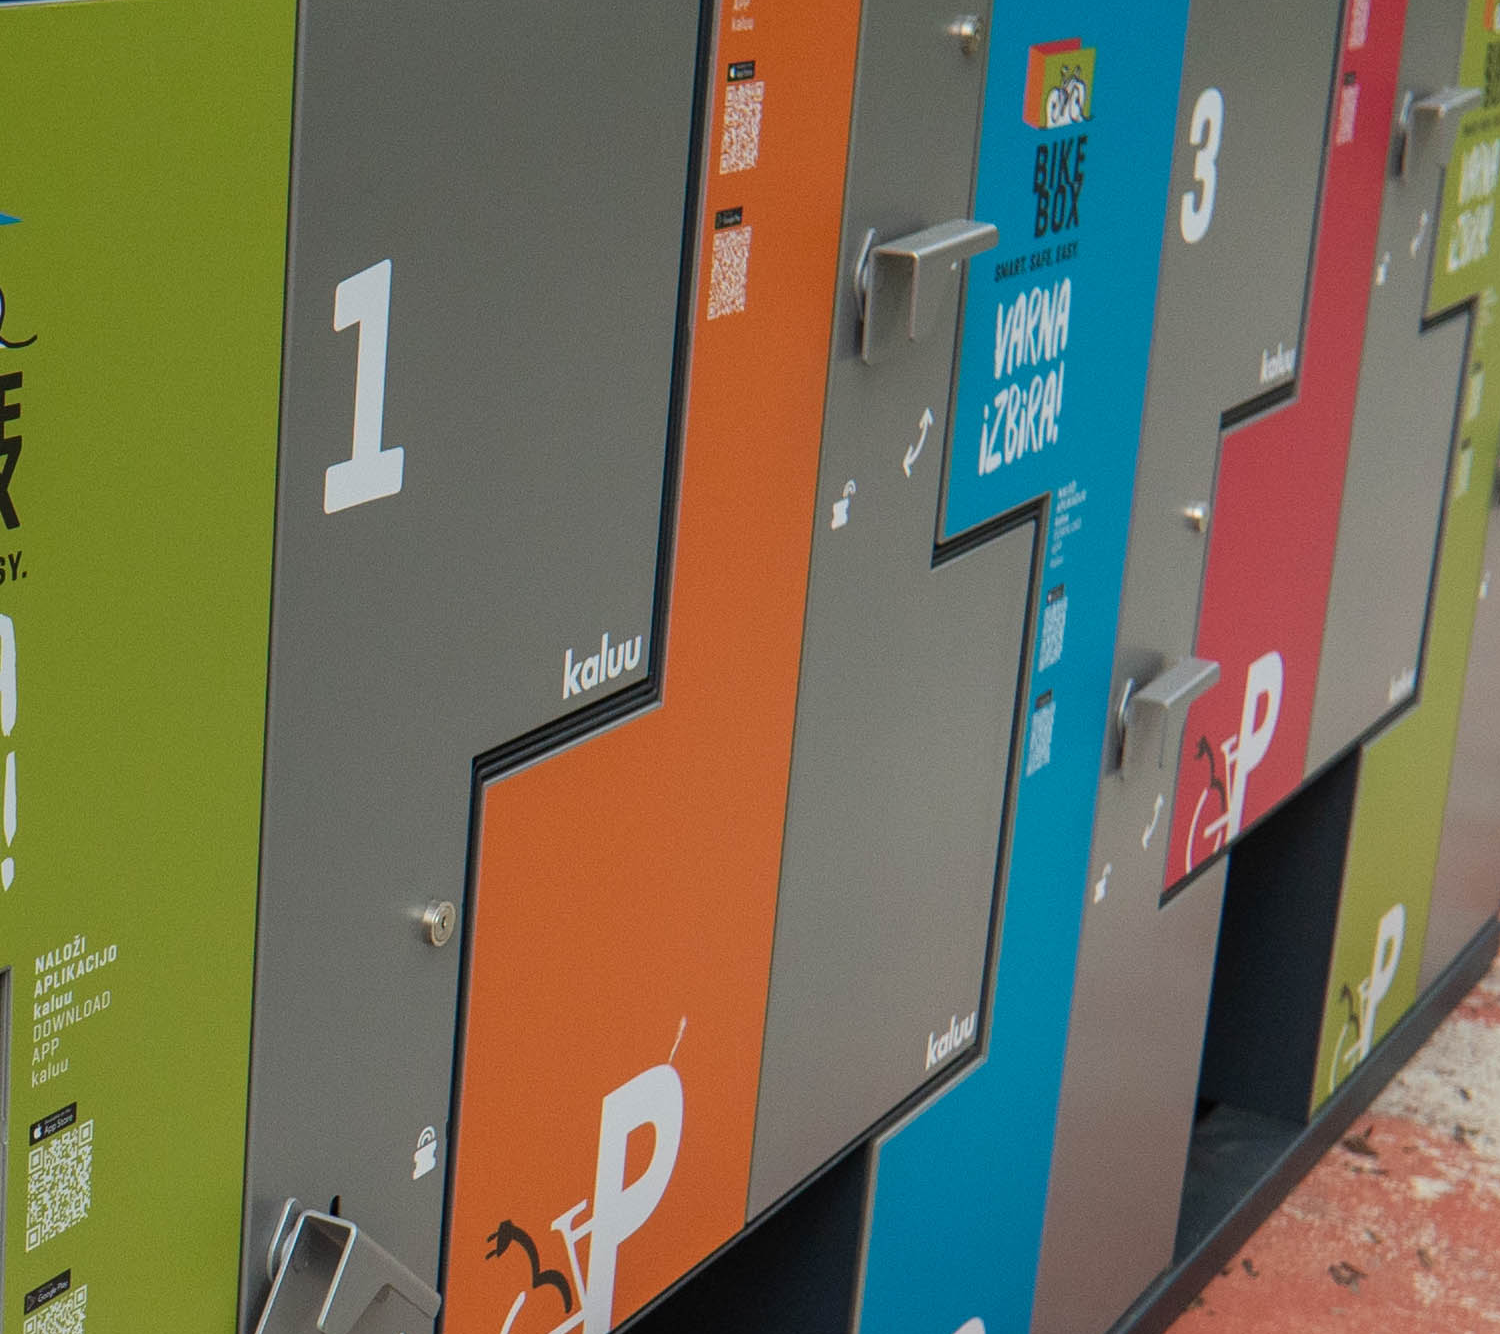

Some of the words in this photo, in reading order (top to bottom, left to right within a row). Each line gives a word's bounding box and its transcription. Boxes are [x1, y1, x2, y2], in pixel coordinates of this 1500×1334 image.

[1032, 135, 1089, 194] BIKE
[1180, 87, 1225, 244] 3
[1034, 181, 1084, 238] BOX
[993, 277, 1071, 380] VARNA
[324, 259, 405, 515] 1
[563, 633, 643, 700] kaluu
[34, 944, 118, 999] APLIKACIJO
[35, 933, 87, 975] NALOŽI
[33, 990, 73, 1021] kaluu
[33, 990, 112, 1043] DOWNLOAD
[31, 1037, 60, 1066] APP
[925, 1011, 977, 1071] kaluu
[31, 1058, 69, 1088] kaluu
